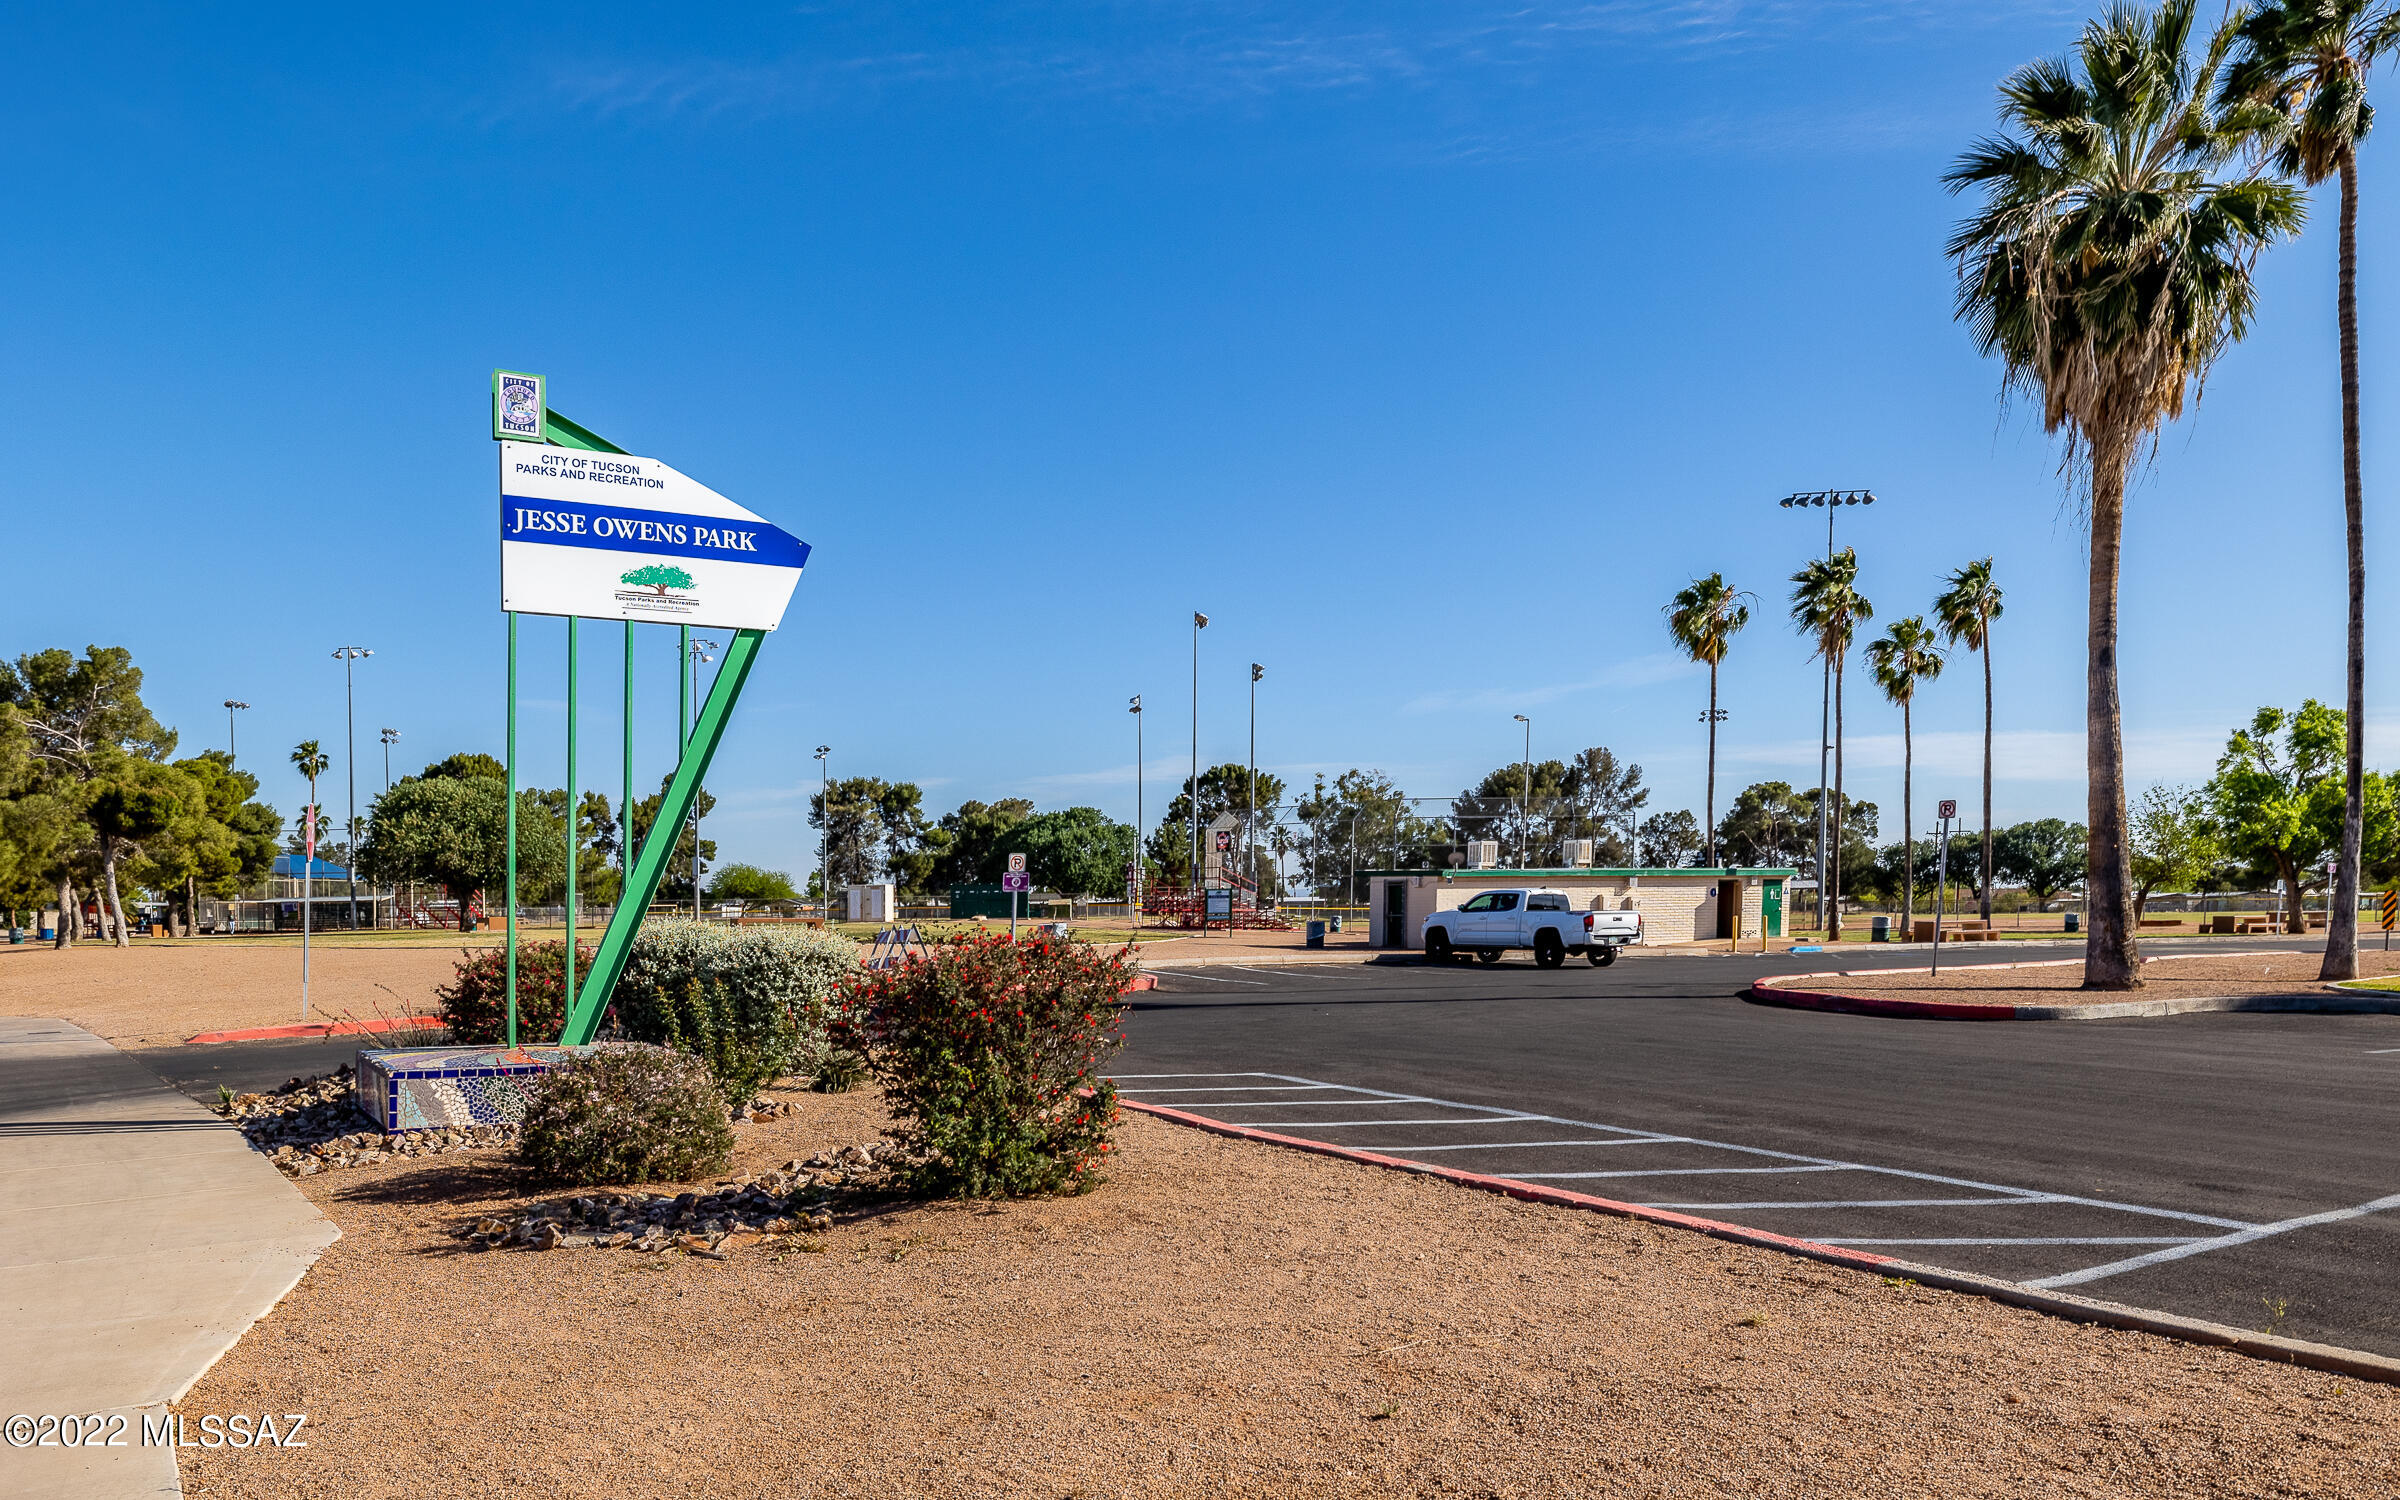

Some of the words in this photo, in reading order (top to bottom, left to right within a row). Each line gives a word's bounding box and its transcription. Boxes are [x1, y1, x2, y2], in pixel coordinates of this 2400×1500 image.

[505, 422, 535, 432] TUCSON
[541, 454, 568, 466] CITY
[572, 458, 588, 469] OF
[591, 460, 640, 475] TUCSON
[516, 463, 557, 477] PARKS
[560, 468, 585, 480] AND
[589, 471, 664, 489] RECREATION
[512, 508, 587, 535] JESSE
[593, 516, 687, 544] OWENS
[693, 526, 757, 552] PARK
[668, 599, 700, 607] Recreation
